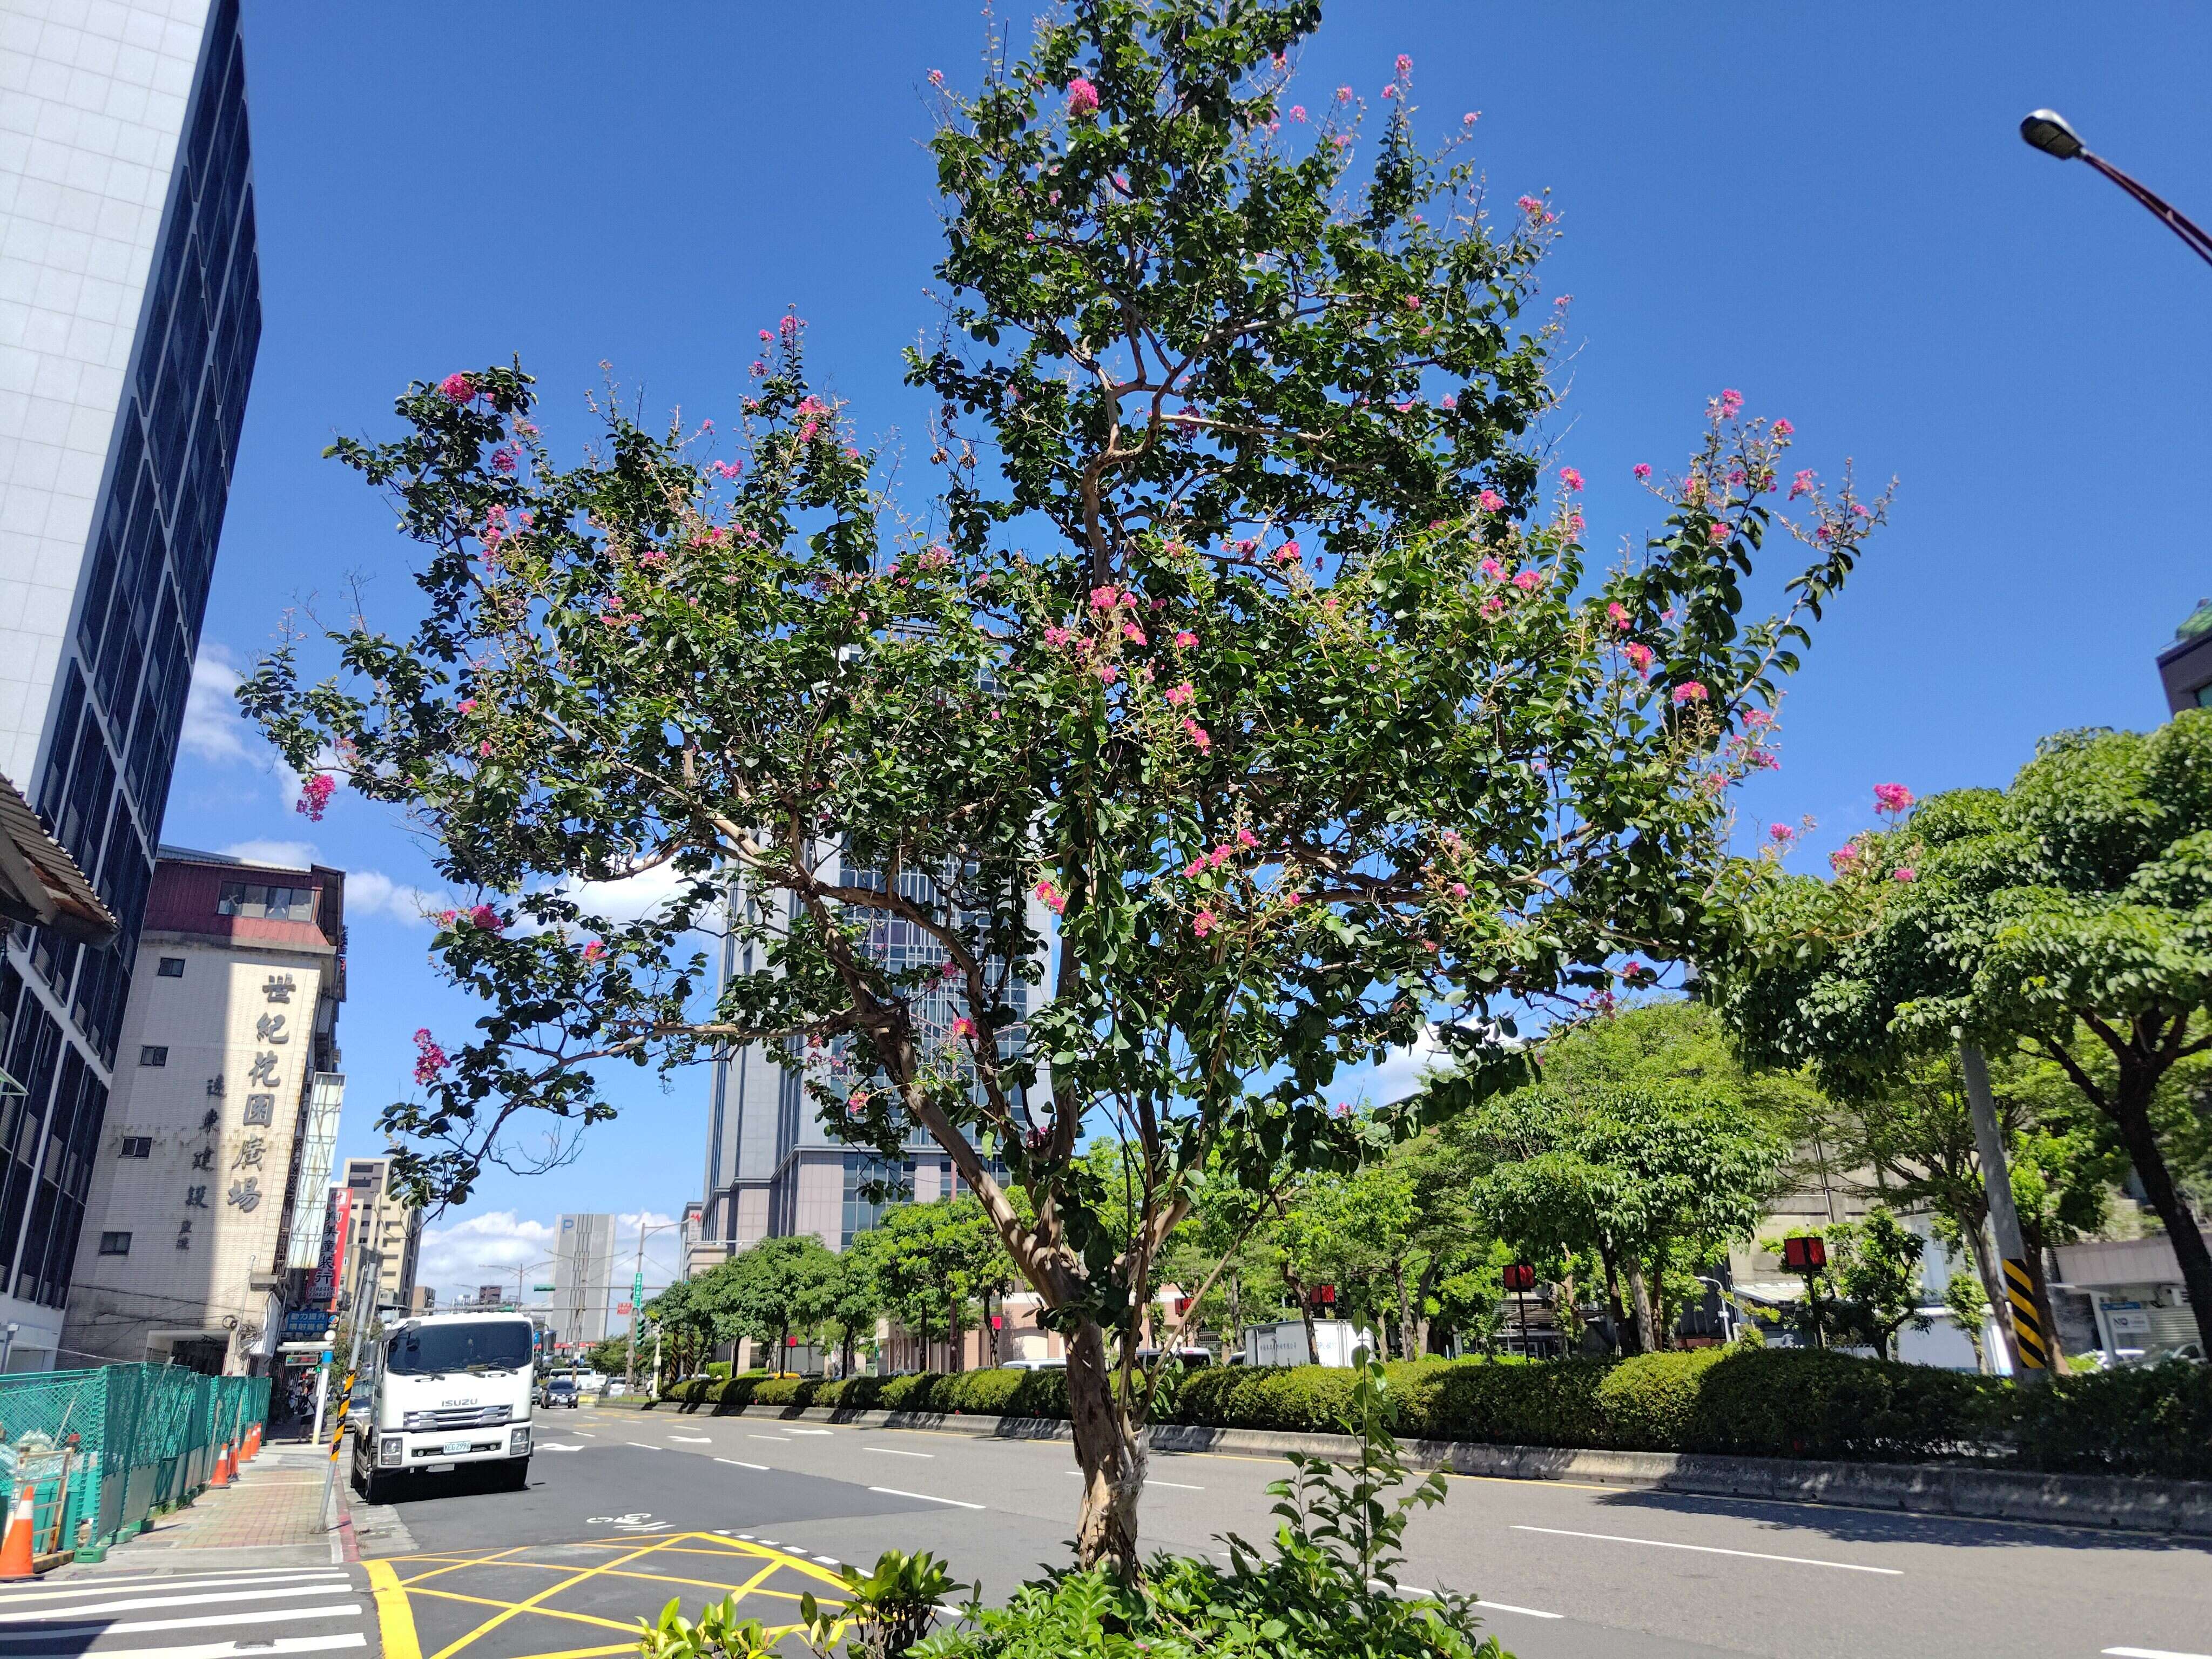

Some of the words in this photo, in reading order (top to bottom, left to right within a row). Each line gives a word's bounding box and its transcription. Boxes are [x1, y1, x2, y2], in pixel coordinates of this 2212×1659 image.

[227, 973, 296, 1213] 世紀花園廣場
[562, 1218, 574, 1234] P
[442, 1398, 478, 1407] ISUZU
[444, 1442, 470, 1452] KEG-2996
